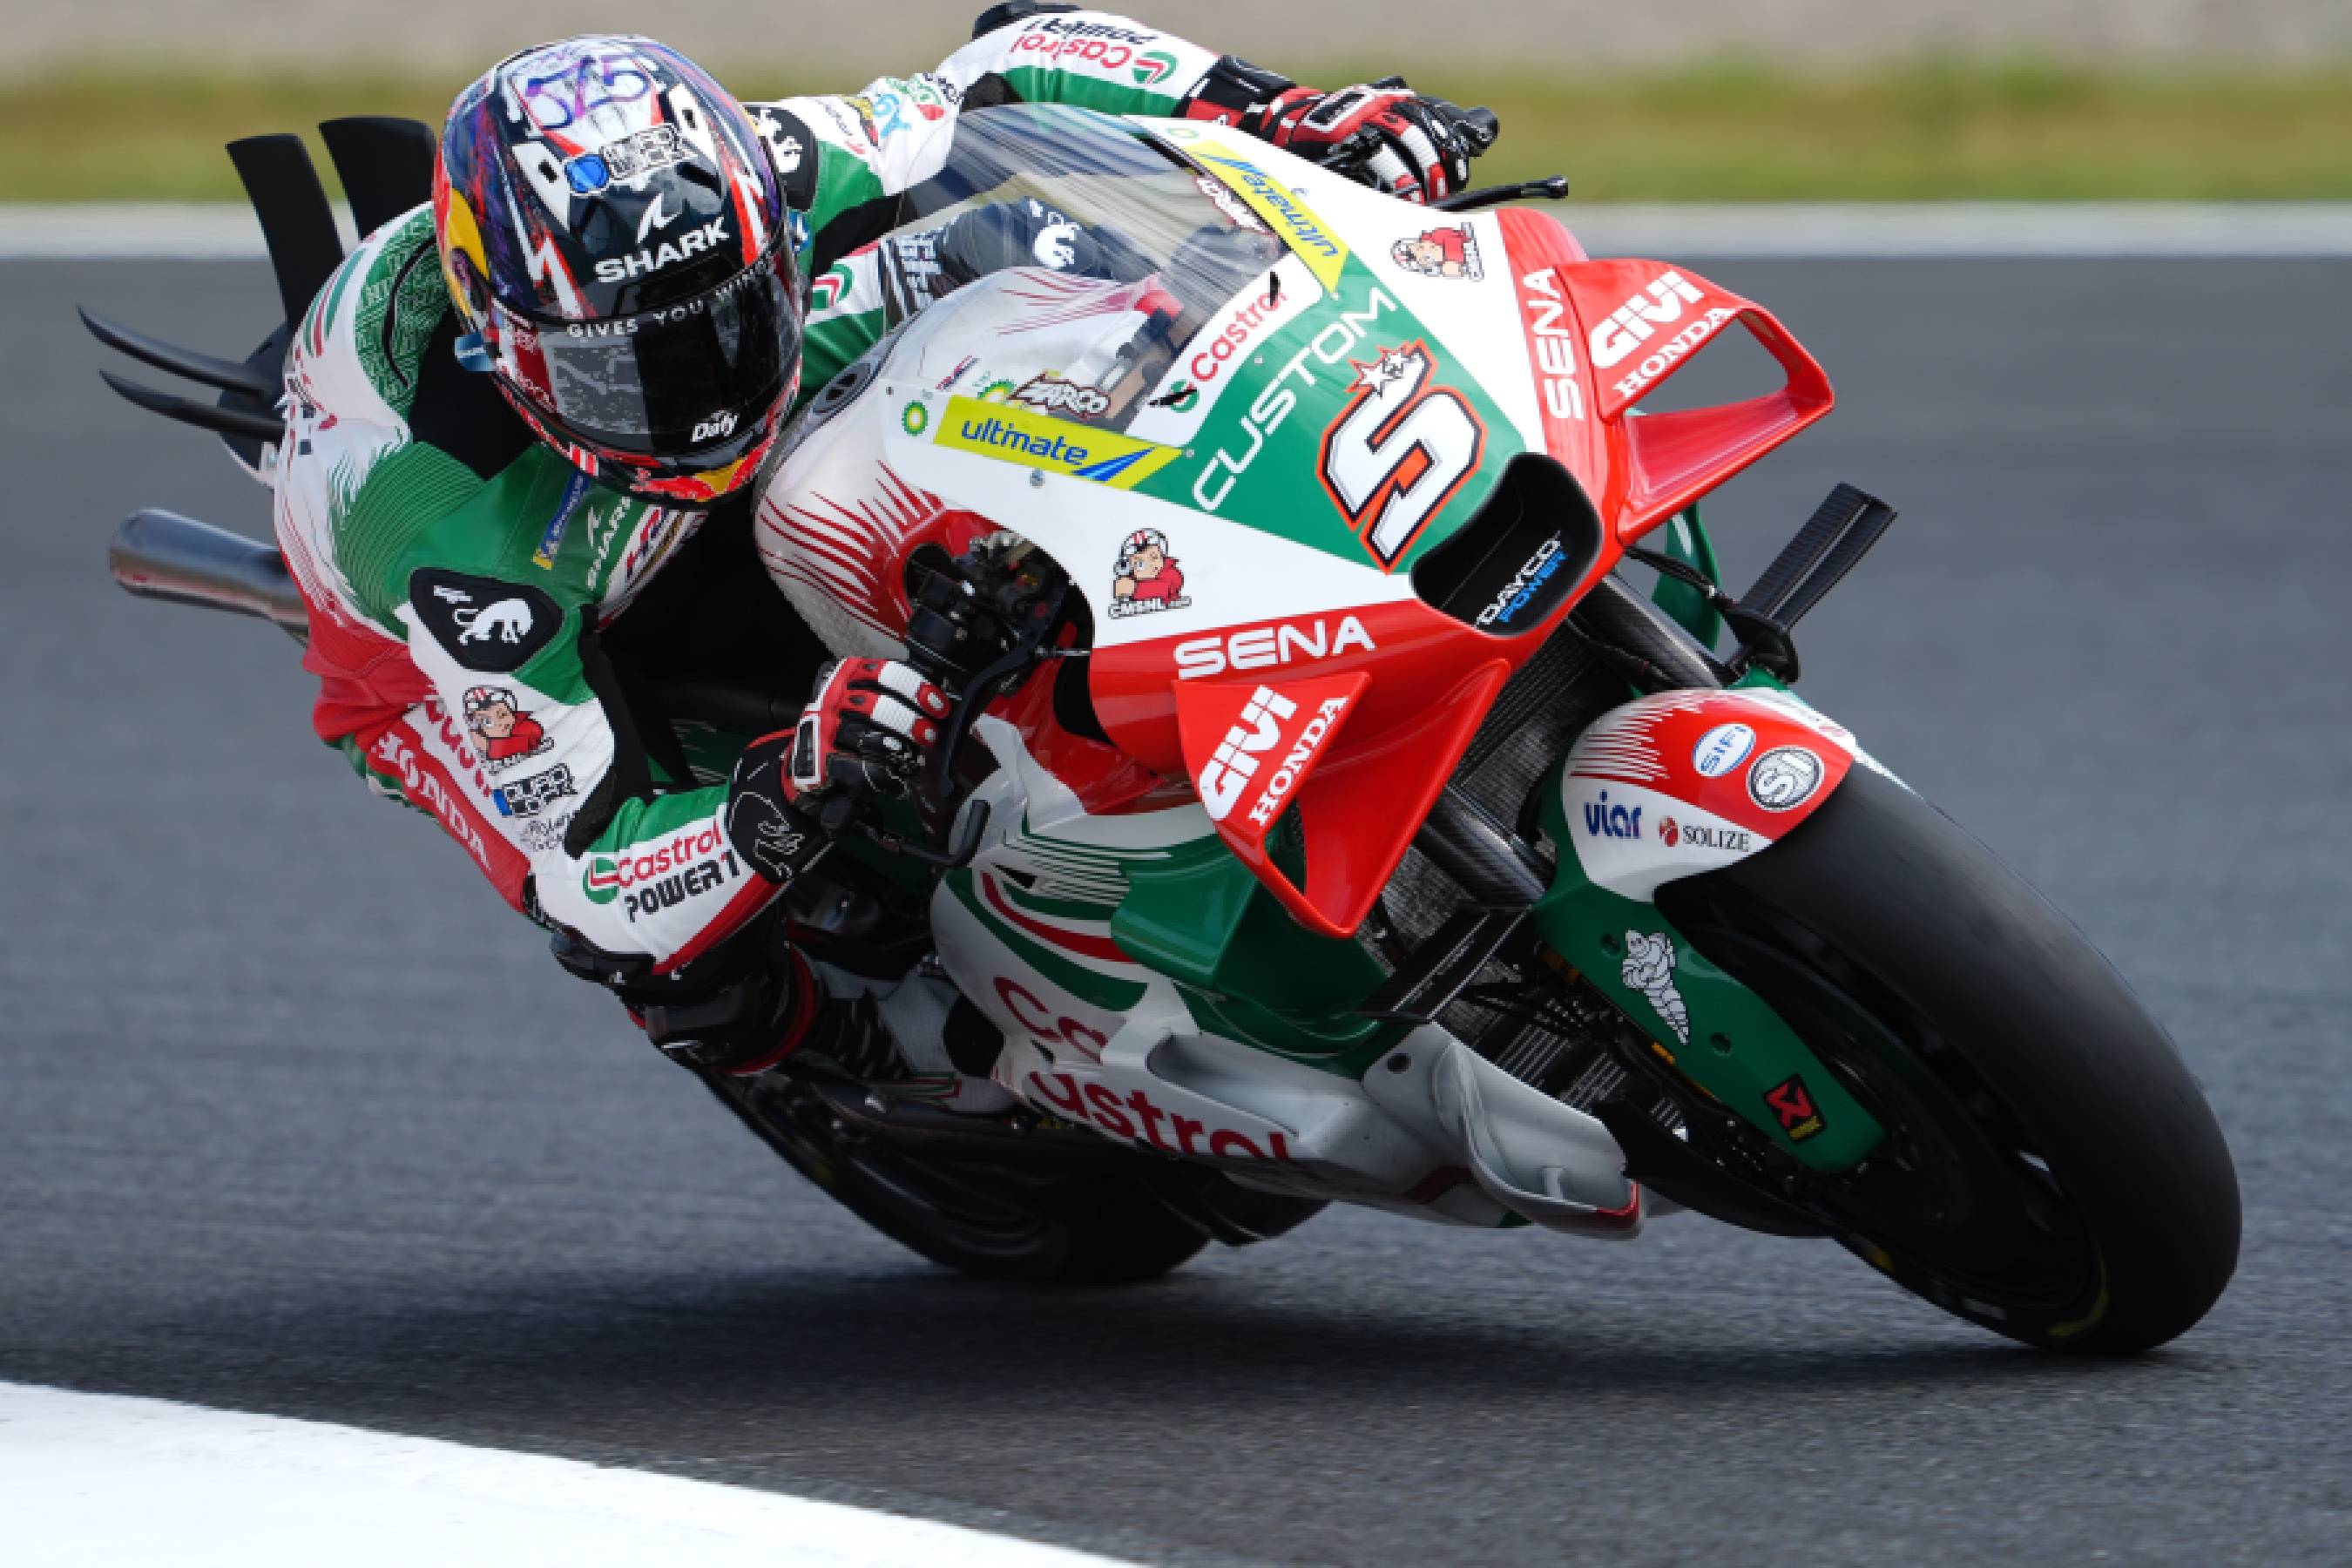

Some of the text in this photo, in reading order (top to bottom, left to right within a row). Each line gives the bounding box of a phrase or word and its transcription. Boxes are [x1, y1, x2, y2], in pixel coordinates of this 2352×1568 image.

[594, 217, 730, 283] SHARK
[1242, 173, 1338, 258] ultimate
[569, 318, 639, 338] GIVES
[653, 299, 704, 326] YOU
[1524, 267, 1584, 421] SENA
[1590, 272, 1704, 369] GIVI
[1612, 307, 1737, 398] HONDA
[1193, 286, 1397, 512] CUSTOM
[962, 418, 1089, 466] ultimate
[1478, 535, 1561, 625] DAYCO
[1498, 551, 1567, 623] POWER
[1174, 616, 1375, 679] SENA
[1200, 685, 1299, 821] GIVI
[1247, 697, 1348, 827] HONDA
[371, 732, 492, 871] HONDA
[1585, 790, 1642, 839] viar
[1683, 825, 1750, 853] SOLIZE
[616, 821, 723, 889] Castrol
